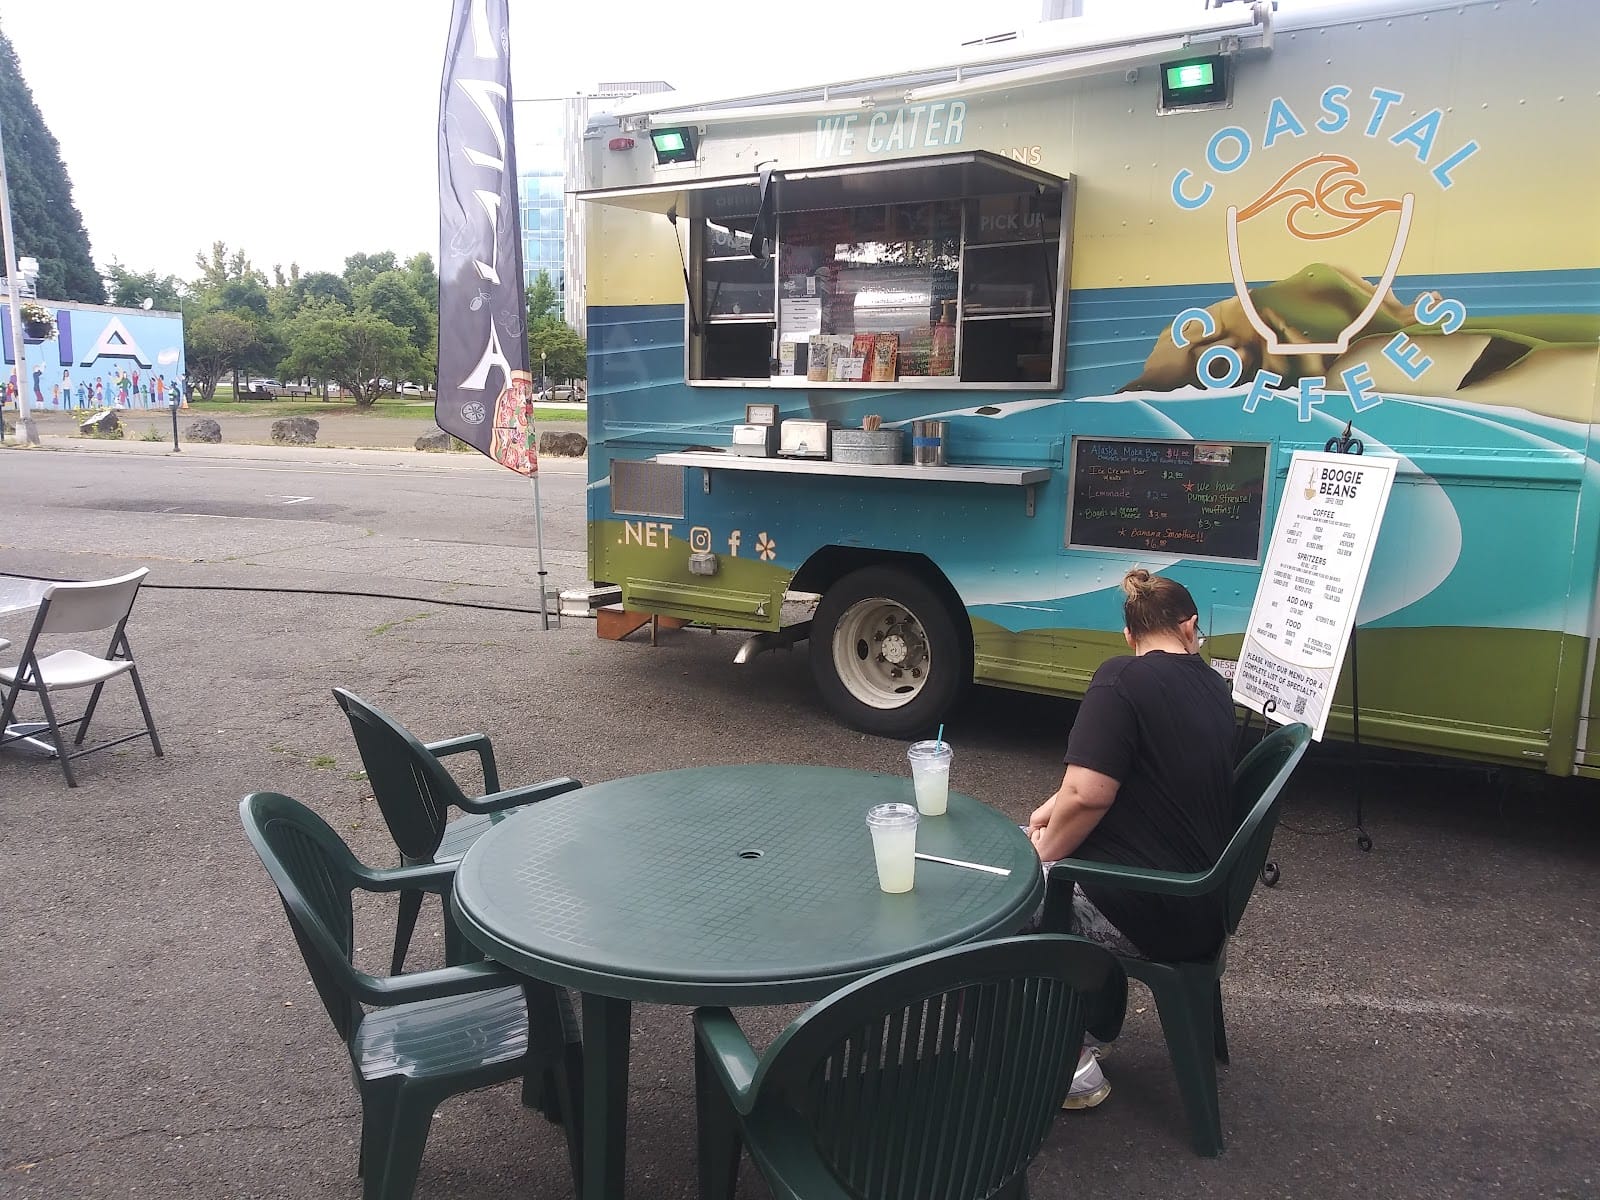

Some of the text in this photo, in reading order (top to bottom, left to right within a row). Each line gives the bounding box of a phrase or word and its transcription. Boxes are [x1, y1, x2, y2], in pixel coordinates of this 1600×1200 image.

[815, 100, 967, 161] WE CATER
[1171, 85, 1480, 211] COASTAL
[981, 214, 1019, 231] PICK
[1171, 292, 1467, 422] COFFEES
[1321, 468, 1364, 485] BOOGIE
[1319, 482, 1358, 499] BEANS
[1312, 508, 1336, 519] COFFEE
[617, 520, 673, 549] .NET
[1296, 552, 1327, 566] SPRITZERS
[1286, 595, 1299, 606] ADD
[1299, 599, 1313, 610] ON'S
[1285, 618, 1302, 630] FOOD
[1242, 670, 1258, 683] DRINKS
[1244, 661, 1317, 698] COMPLETE LIST OF SPECIALTY
[1246, 652, 1323, 690] PLEASE VISIT OUR MENU FOR A
